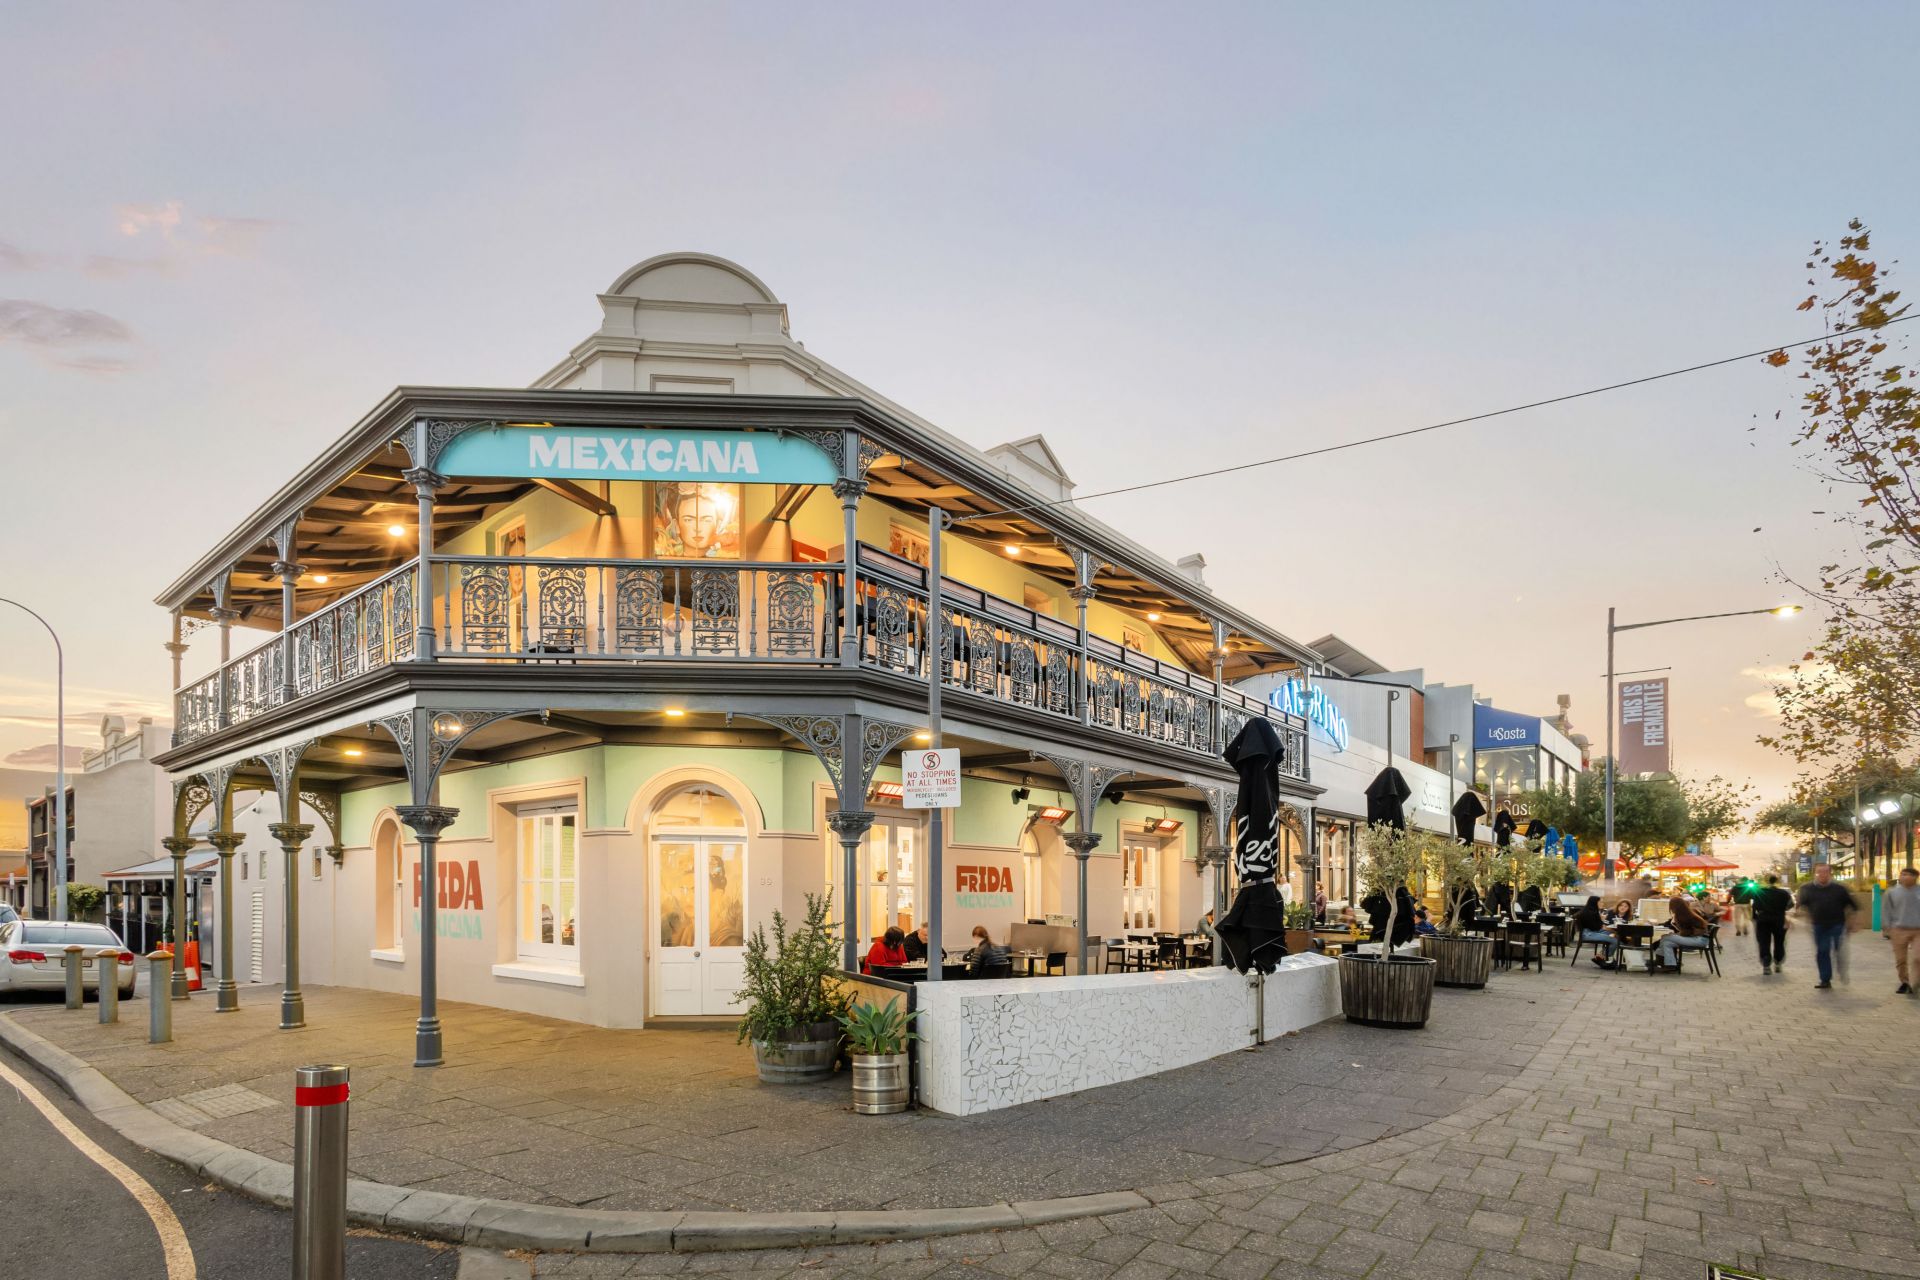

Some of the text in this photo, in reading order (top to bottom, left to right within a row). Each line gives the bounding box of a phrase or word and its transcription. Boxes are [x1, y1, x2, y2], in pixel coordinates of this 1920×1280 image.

[528, 435, 760, 474] MEXICANA
[1623, 684, 1642, 725] THIS IS
[1643, 682, 1664, 746] FREMANTLE
[906, 779, 915, 787] AT
[935, 778, 957, 786] TIMES
[907, 769, 956, 779] NO STOPPING
[413, 859, 484, 911] FIDA
[956, 865, 1014, 893] FRIDA
